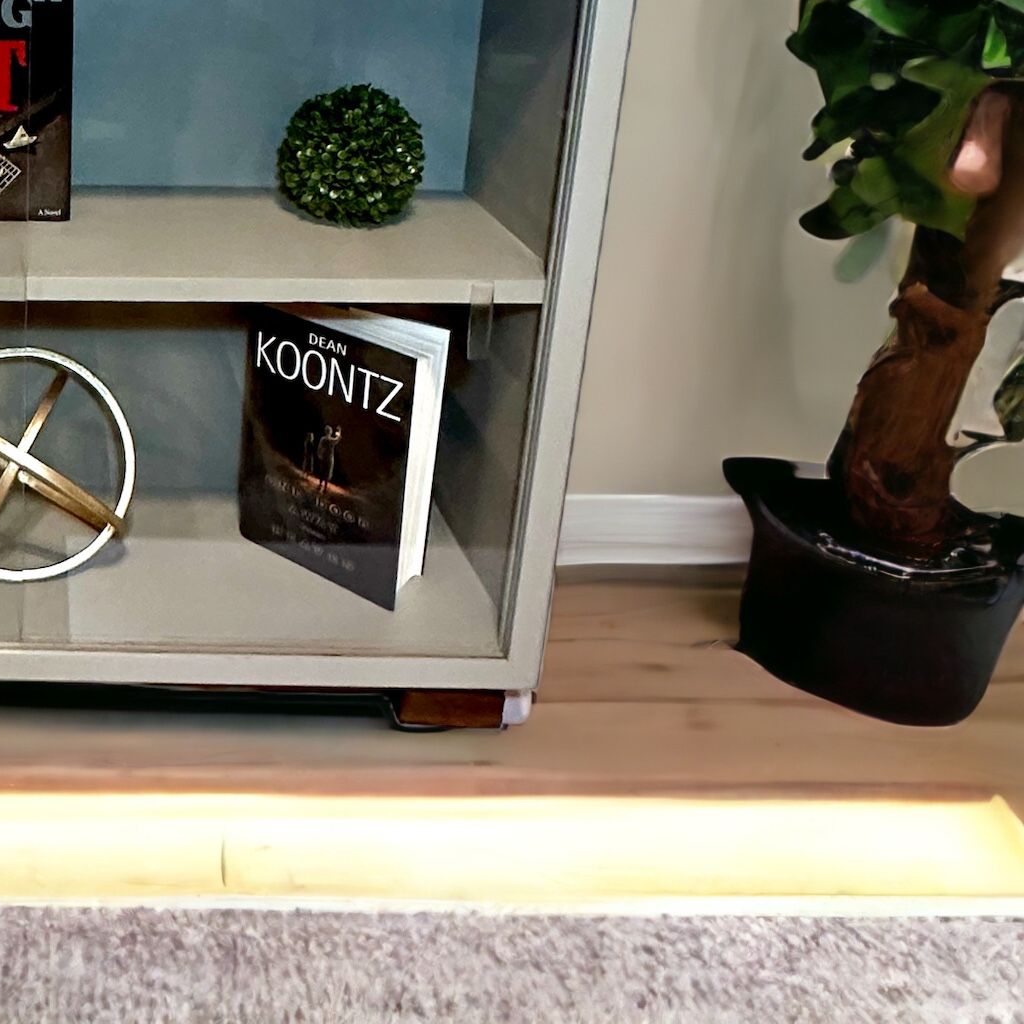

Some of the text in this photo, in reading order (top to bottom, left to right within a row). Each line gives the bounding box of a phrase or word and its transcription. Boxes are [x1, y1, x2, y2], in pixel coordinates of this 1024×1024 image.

[38, 208, 44, 216] A
[308, 332, 347, 357] DEAN
[256, 331, 405, 422] KOONTZ
